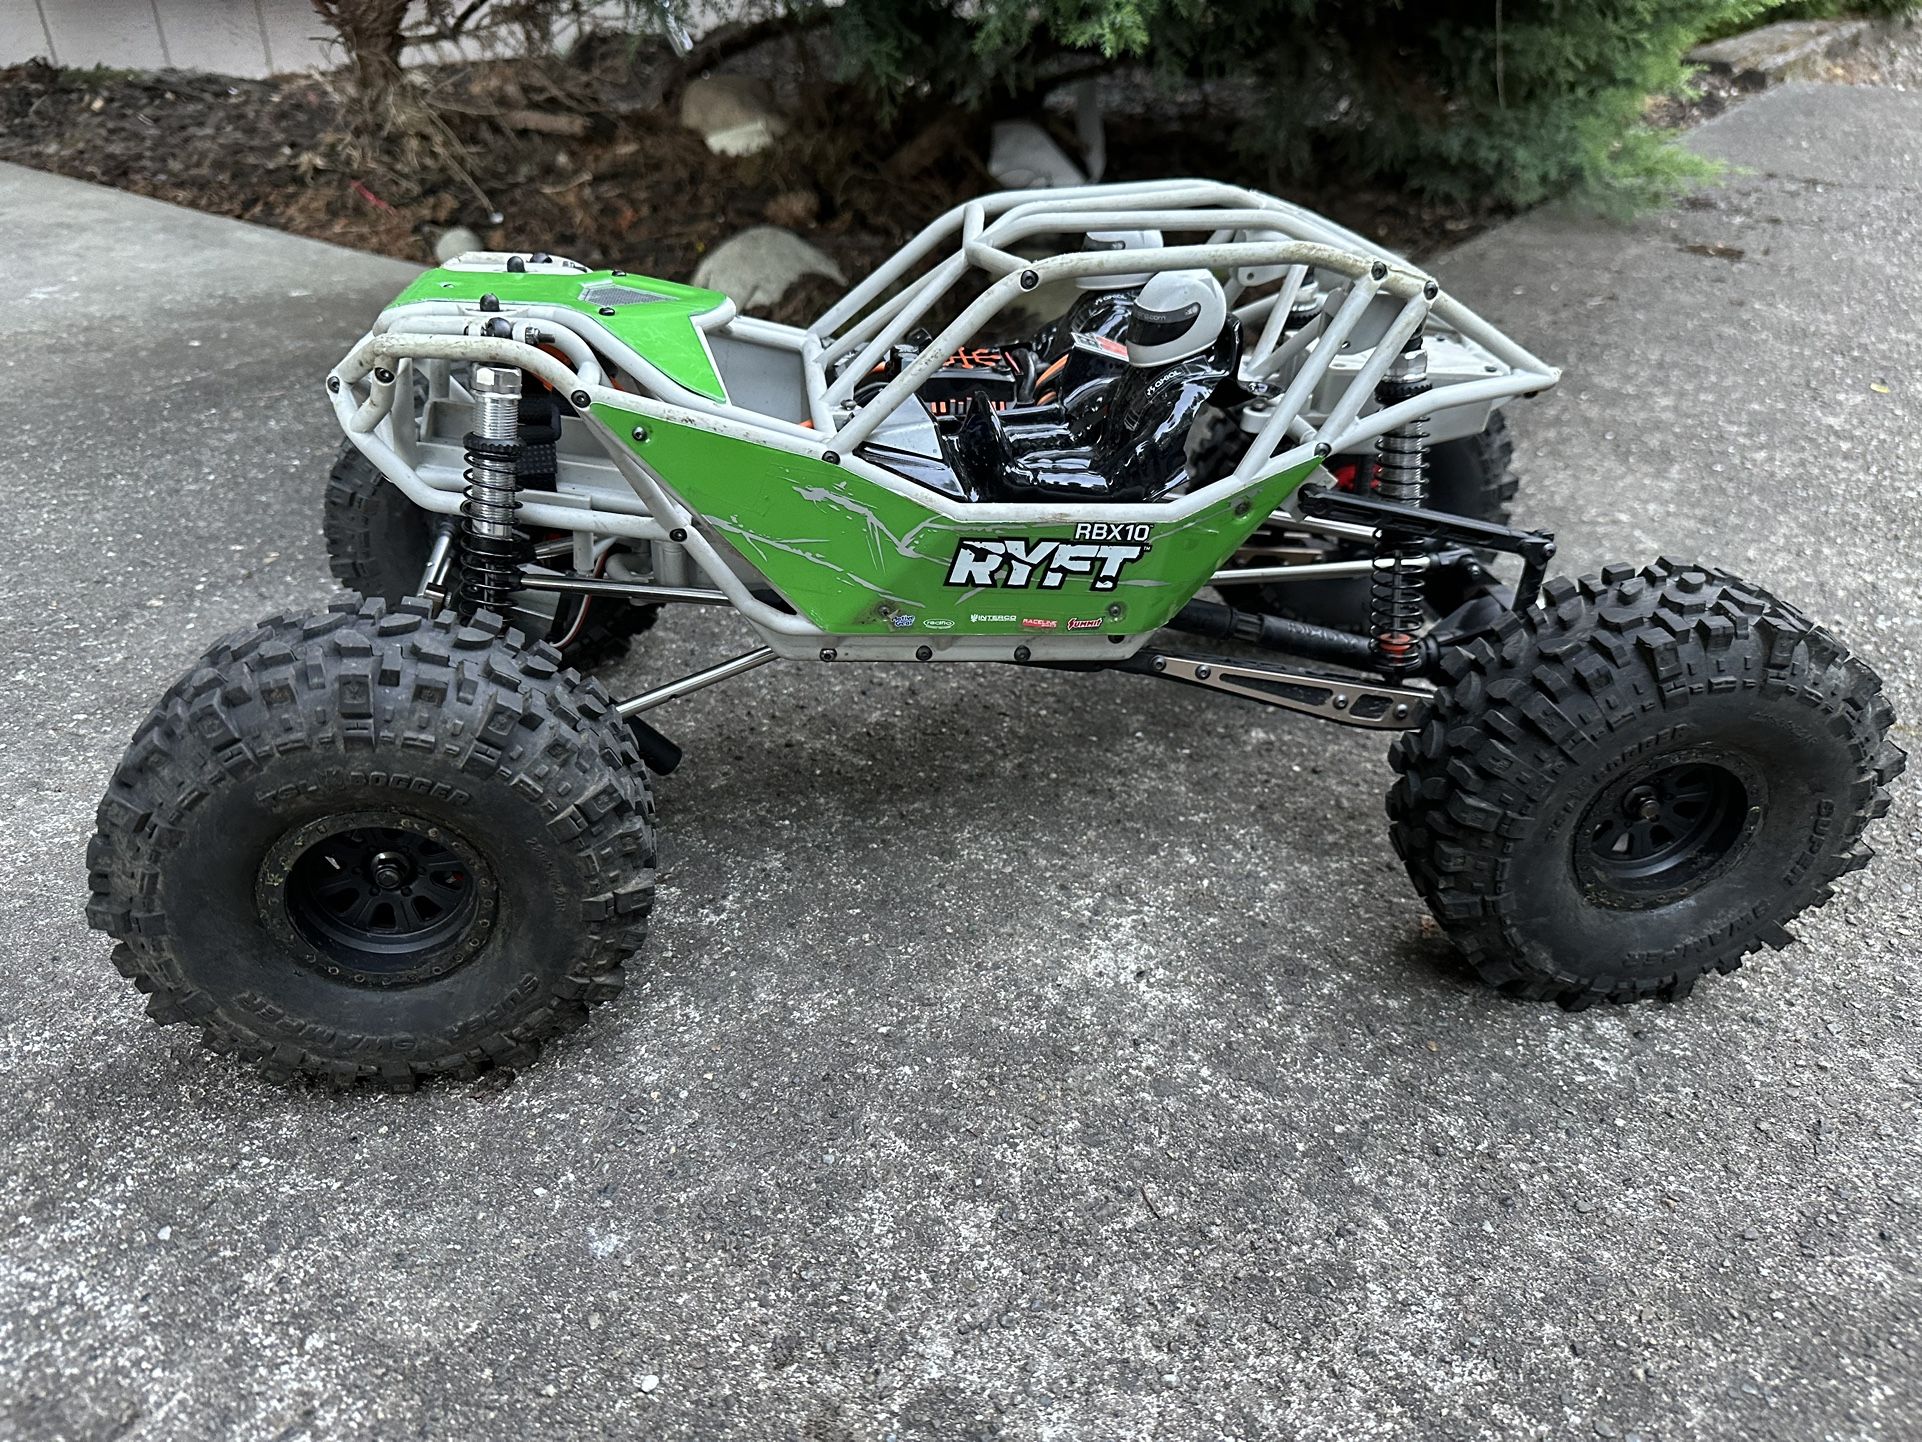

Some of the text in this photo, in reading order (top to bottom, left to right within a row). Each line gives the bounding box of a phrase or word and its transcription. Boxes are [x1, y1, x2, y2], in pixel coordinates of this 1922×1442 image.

[1074, 523, 1150, 541] RBX10
[946, 539, 1144, 590] RYFT
[1067, 617, 1103, 630] SUMMIT
[350, 771, 472, 807] BOGGER
[1782, 798, 1836, 888] SUPER
